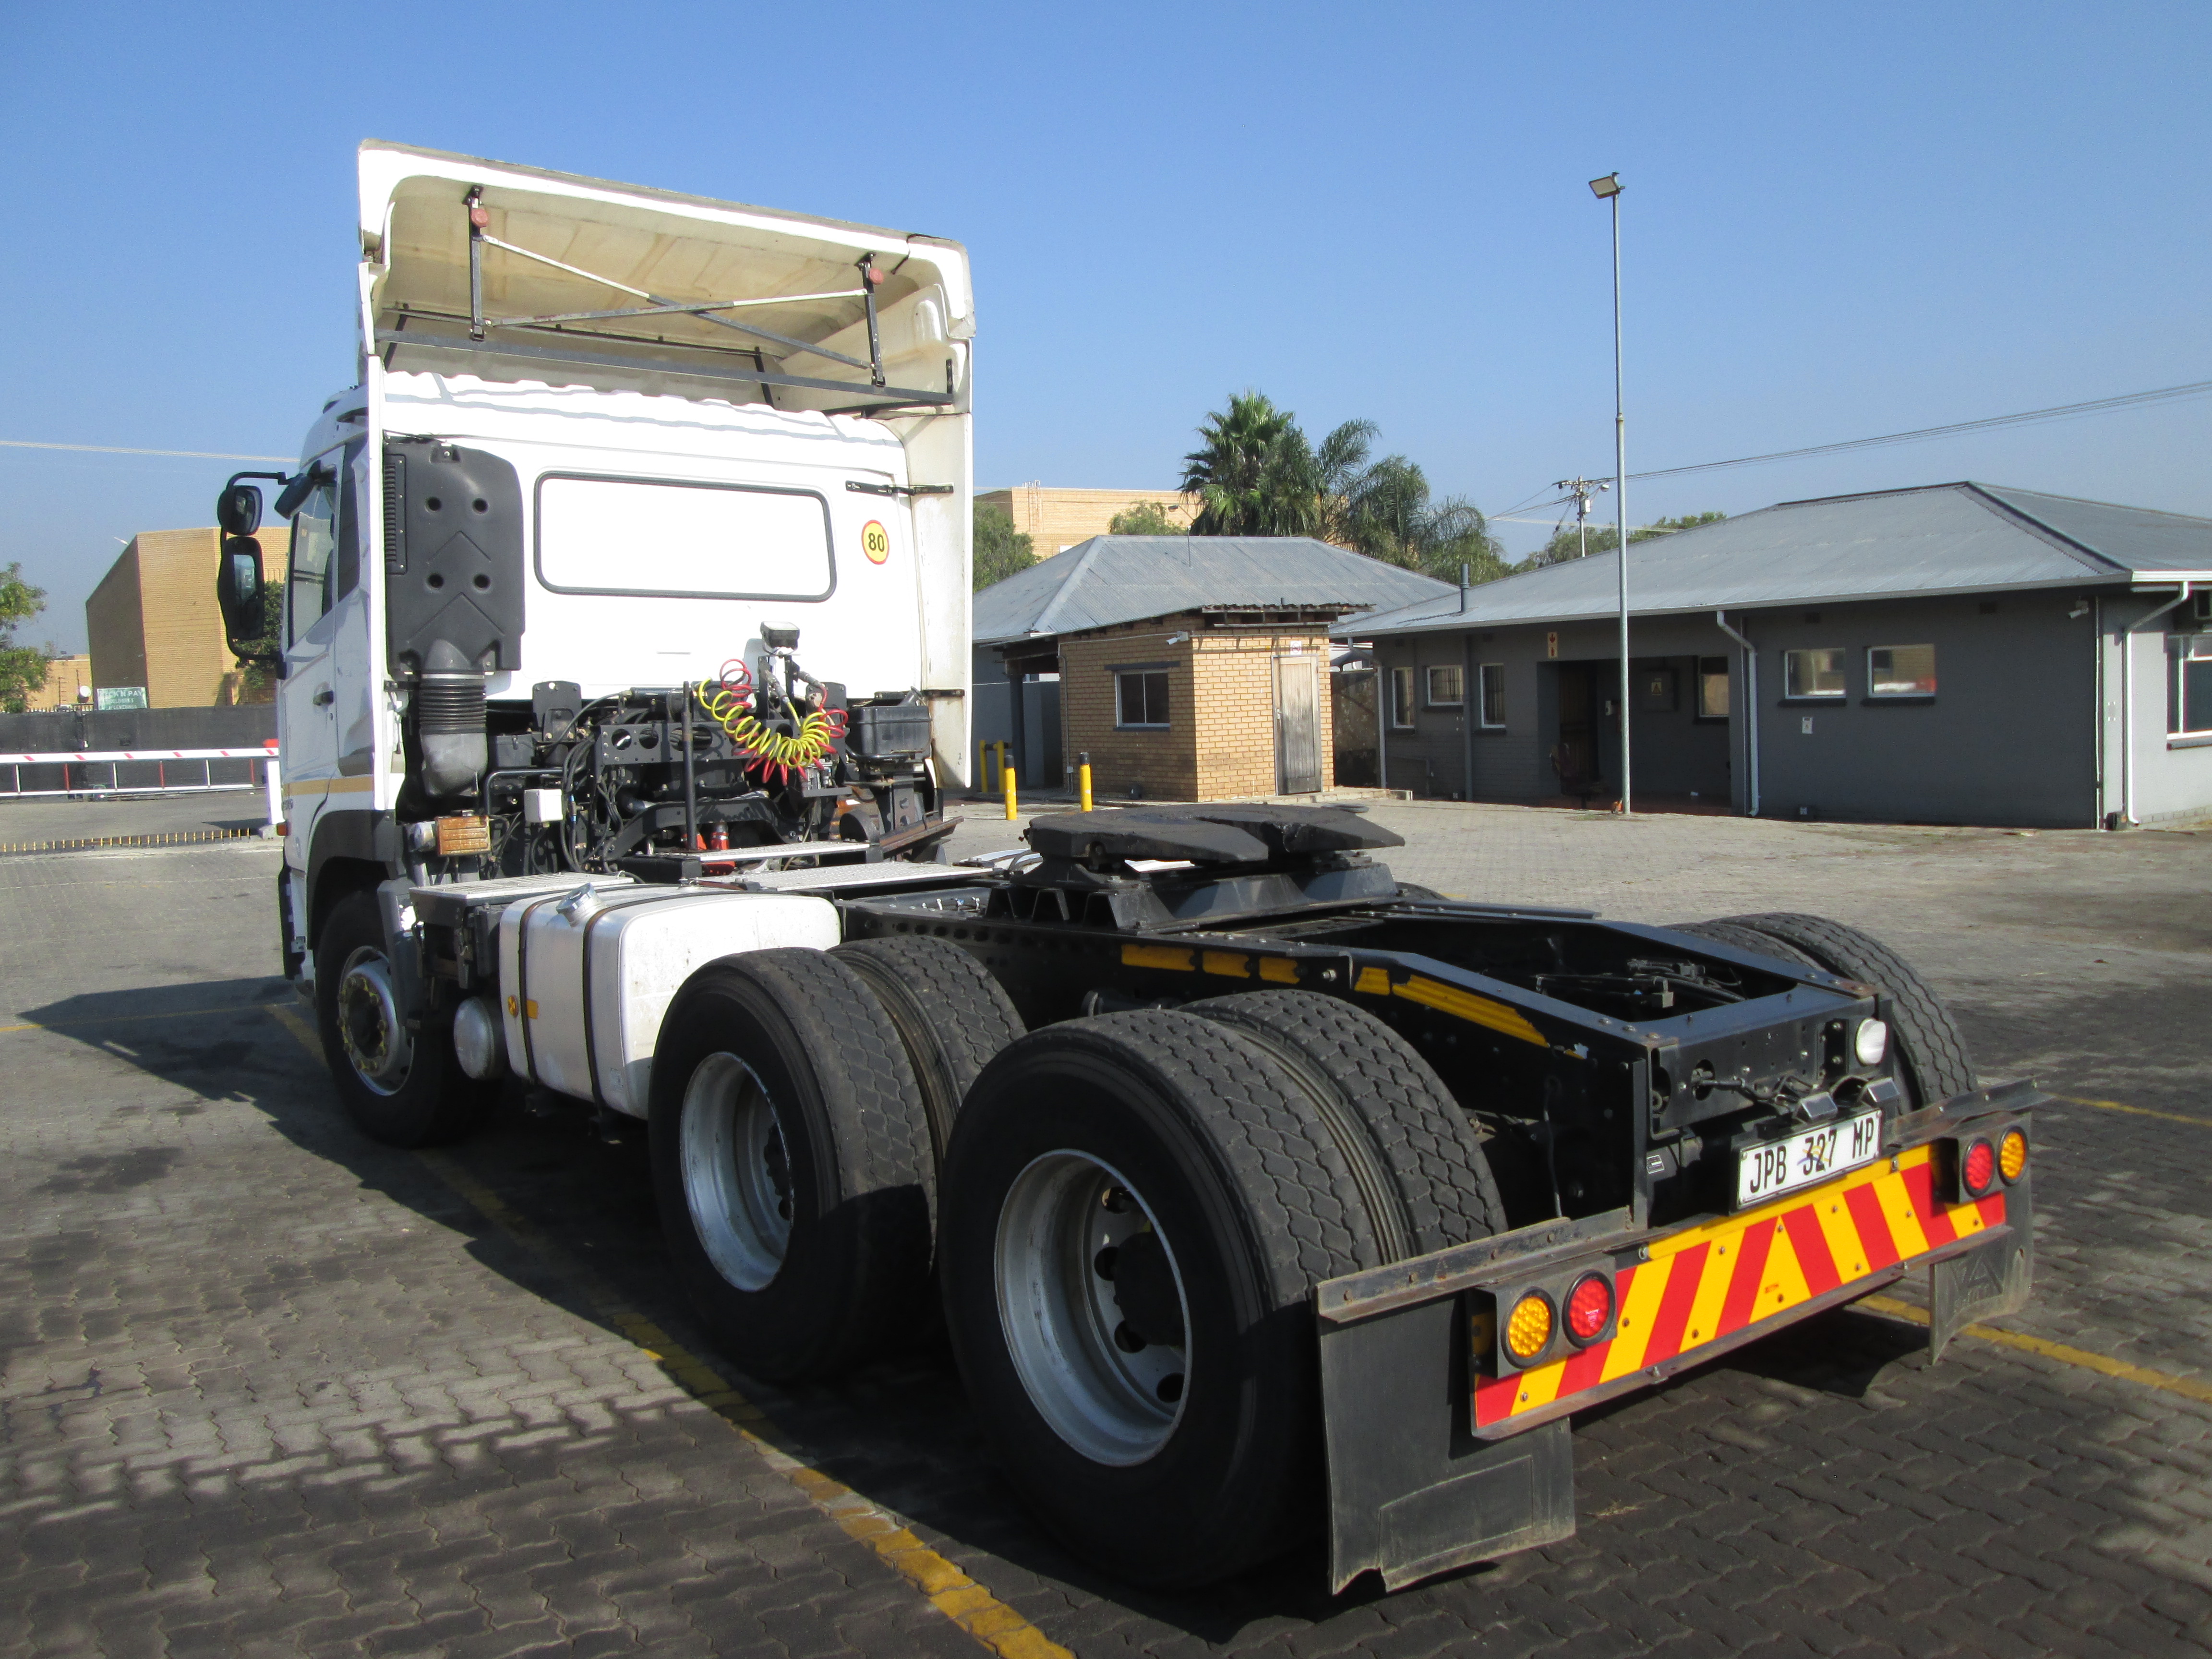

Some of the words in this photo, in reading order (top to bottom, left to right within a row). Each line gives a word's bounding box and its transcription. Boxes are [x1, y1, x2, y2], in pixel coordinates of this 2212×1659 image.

[868, 532, 885, 553] 80
[1750, 1145, 1787, 1193] JPB
[1803, 1129, 1838, 1176] 327
[1852, 1117, 1874, 1159] MP
